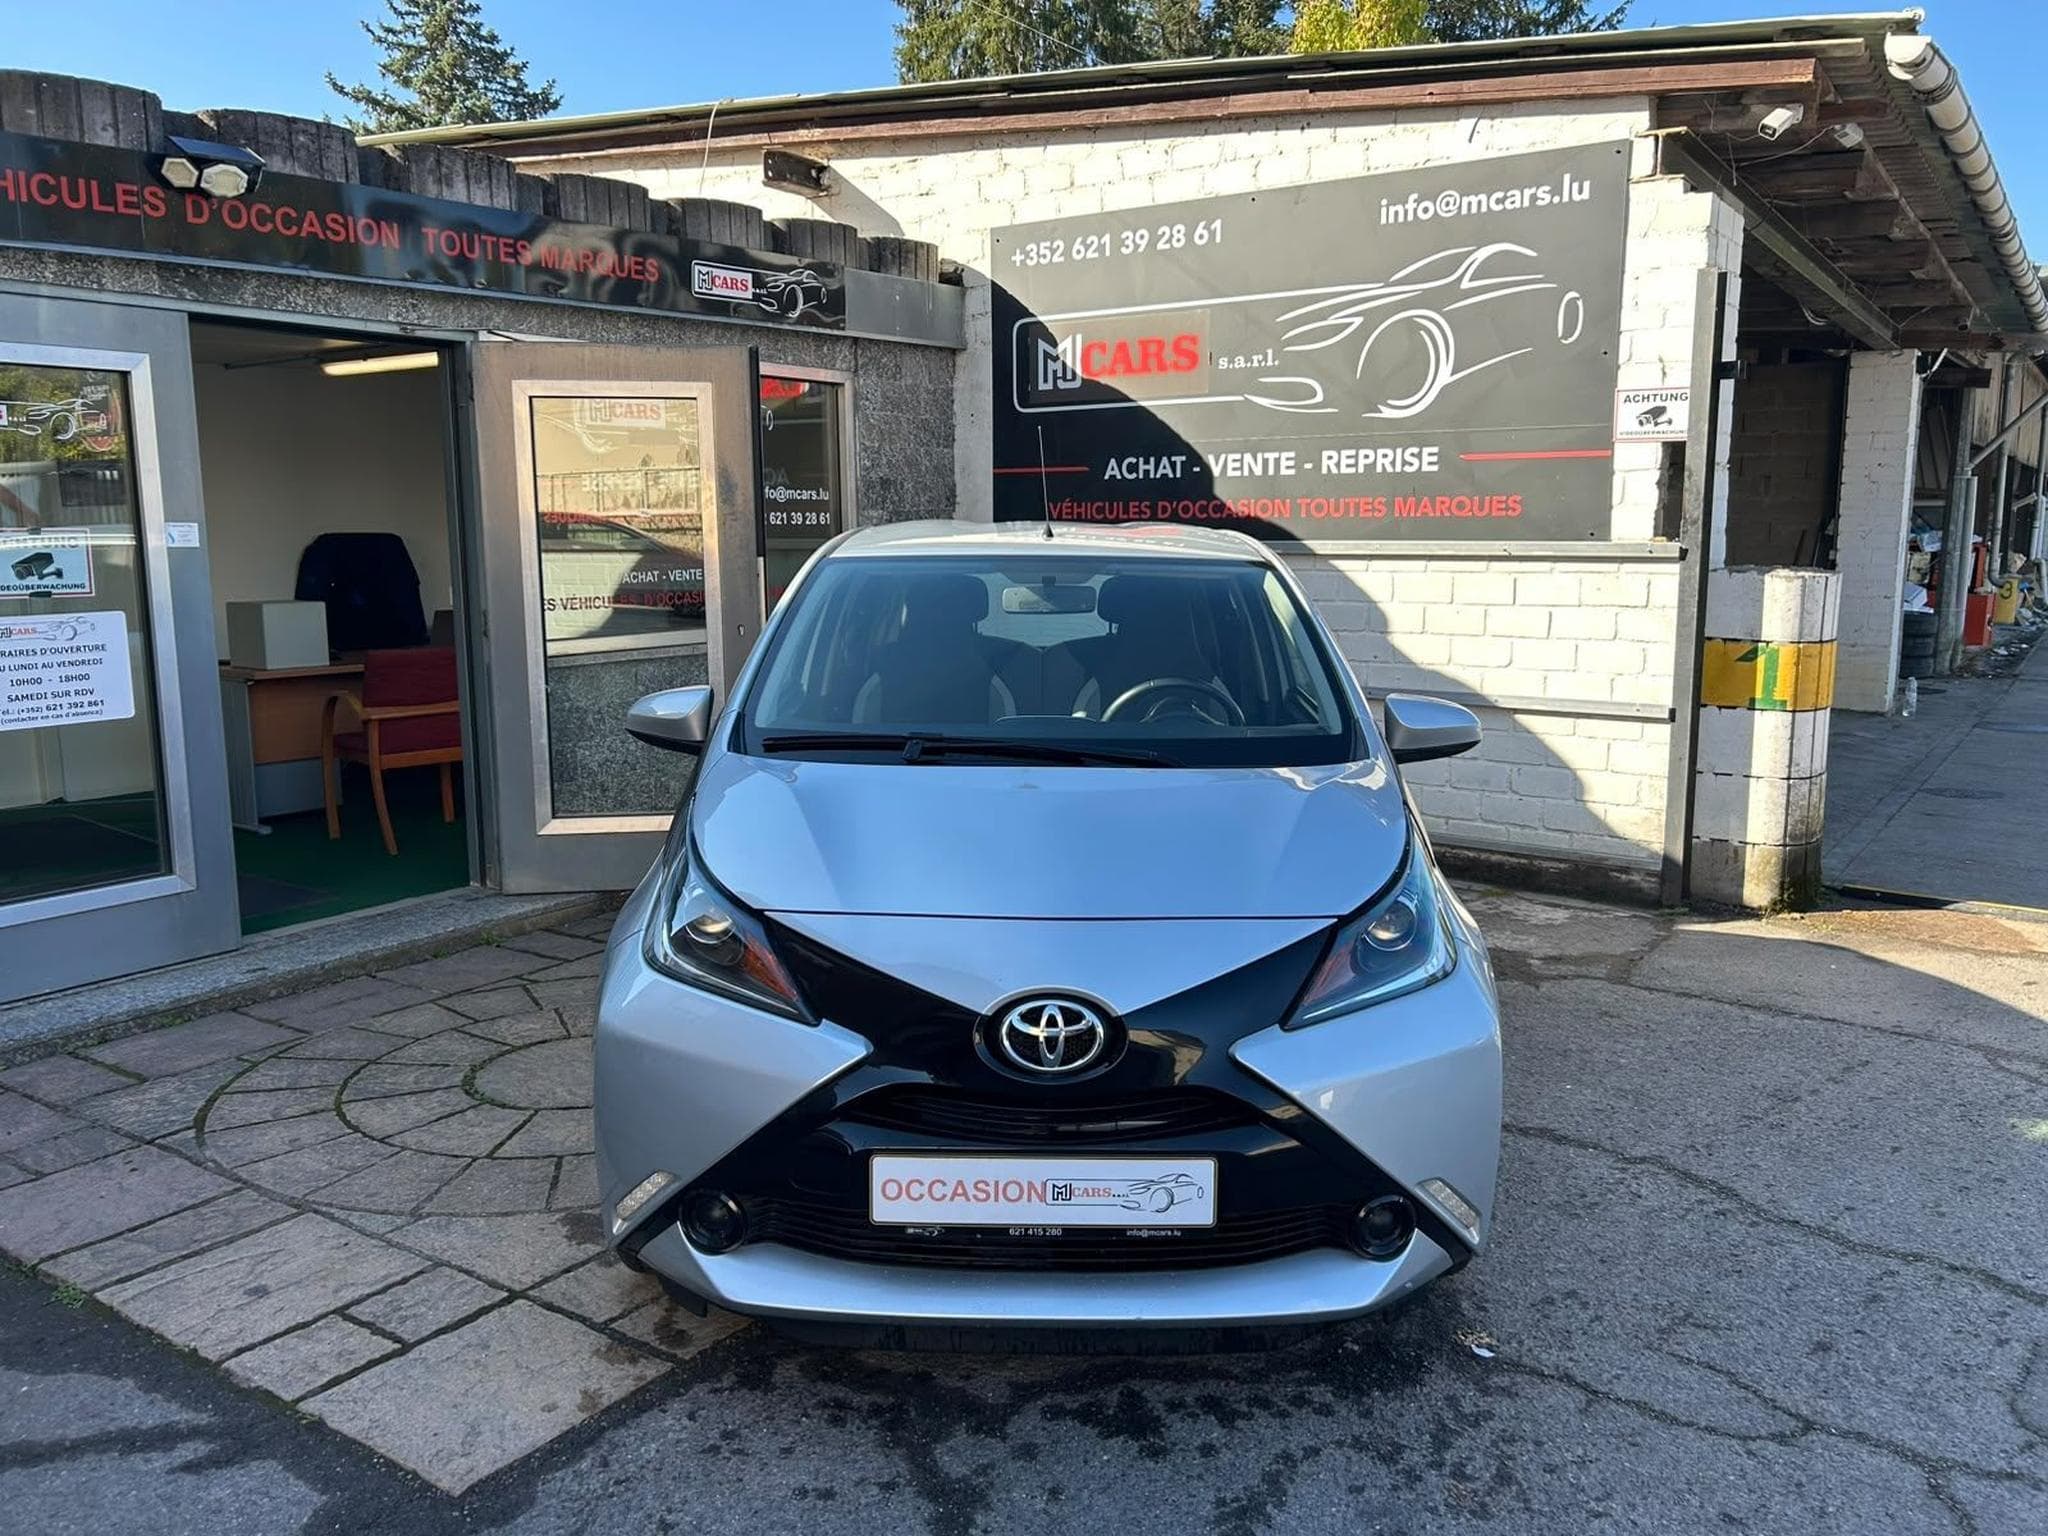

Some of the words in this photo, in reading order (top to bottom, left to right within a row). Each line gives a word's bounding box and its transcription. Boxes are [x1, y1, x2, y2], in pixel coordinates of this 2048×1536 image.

[1380, 173, 1590, 225] info@mcars.lu
[184, 193, 399, 249] D'OCCASION
[422, 227, 532, 266] TOUTES
[541, 244, 659, 283] MARQUES
[1011, 240, 1064, 267] +352
[1071, 234, 1111, 261] 621
[1120, 228, 1149, 255] 39
[1156, 223, 1186, 250] 28
[1193, 218, 1222, 245] 61
[1081, 333, 1200, 378] CARS
[1219, 349, 1280, 369] s.a.r.l.
[1623, 392, 1689, 404] ACHTUNG
[611, 403, 662, 421] CARS
[1104, 456, 1186, 480] ACHAT
[1209, 452, 1296, 477] VENTE
[1321, 446, 1440, 475] REPRISE
[765, 486, 829, 503] fo@mcars.lu
[1050, 499, 1150, 520] VÉHICULES
[1157, 498, 1291, 519] D'OCCASION
[1297, 497, 1387, 518] TOUTES
[1394, 495, 1523, 517] MARQUES
[769, 512, 787, 525] 621
[790, 512, 803, 525] 39
[805, 512, 817, 525] 28
[819, 512, 830, 525] 61
[622, 570, 659, 584] ACHAT
[667, 568, 703, 581] VENTE
[2000, 580, 2013, 600] 3
[0, 648, 37, 658] RAIRES
[40, 643, 107, 656] D'OUVERTURE
[8, 662, 38, 672] LUNDI
[41, 661, 54, 670] AU
[56, 657, 103, 668] VENDREDI
[10, 677, 42, 687] 10H00
[59, 673, 90, 683] 18H00
[1735, 643, 1787, 711] 1
[7, 692, 48, 703] SAMEDI
[51, 690, 71, 699] SUR
[74, 688, 95, 697] RDV
[46, 703, 63, 712] 621
[67, 701, 85, 709] 392
[881, 1178, 1045, 1203] OCCASION
[1072, 1186, 1112, 1198] CARS
[1009, 1228, 1025, 1236] 621
[1027, 1228, 1043, 1236] 415
